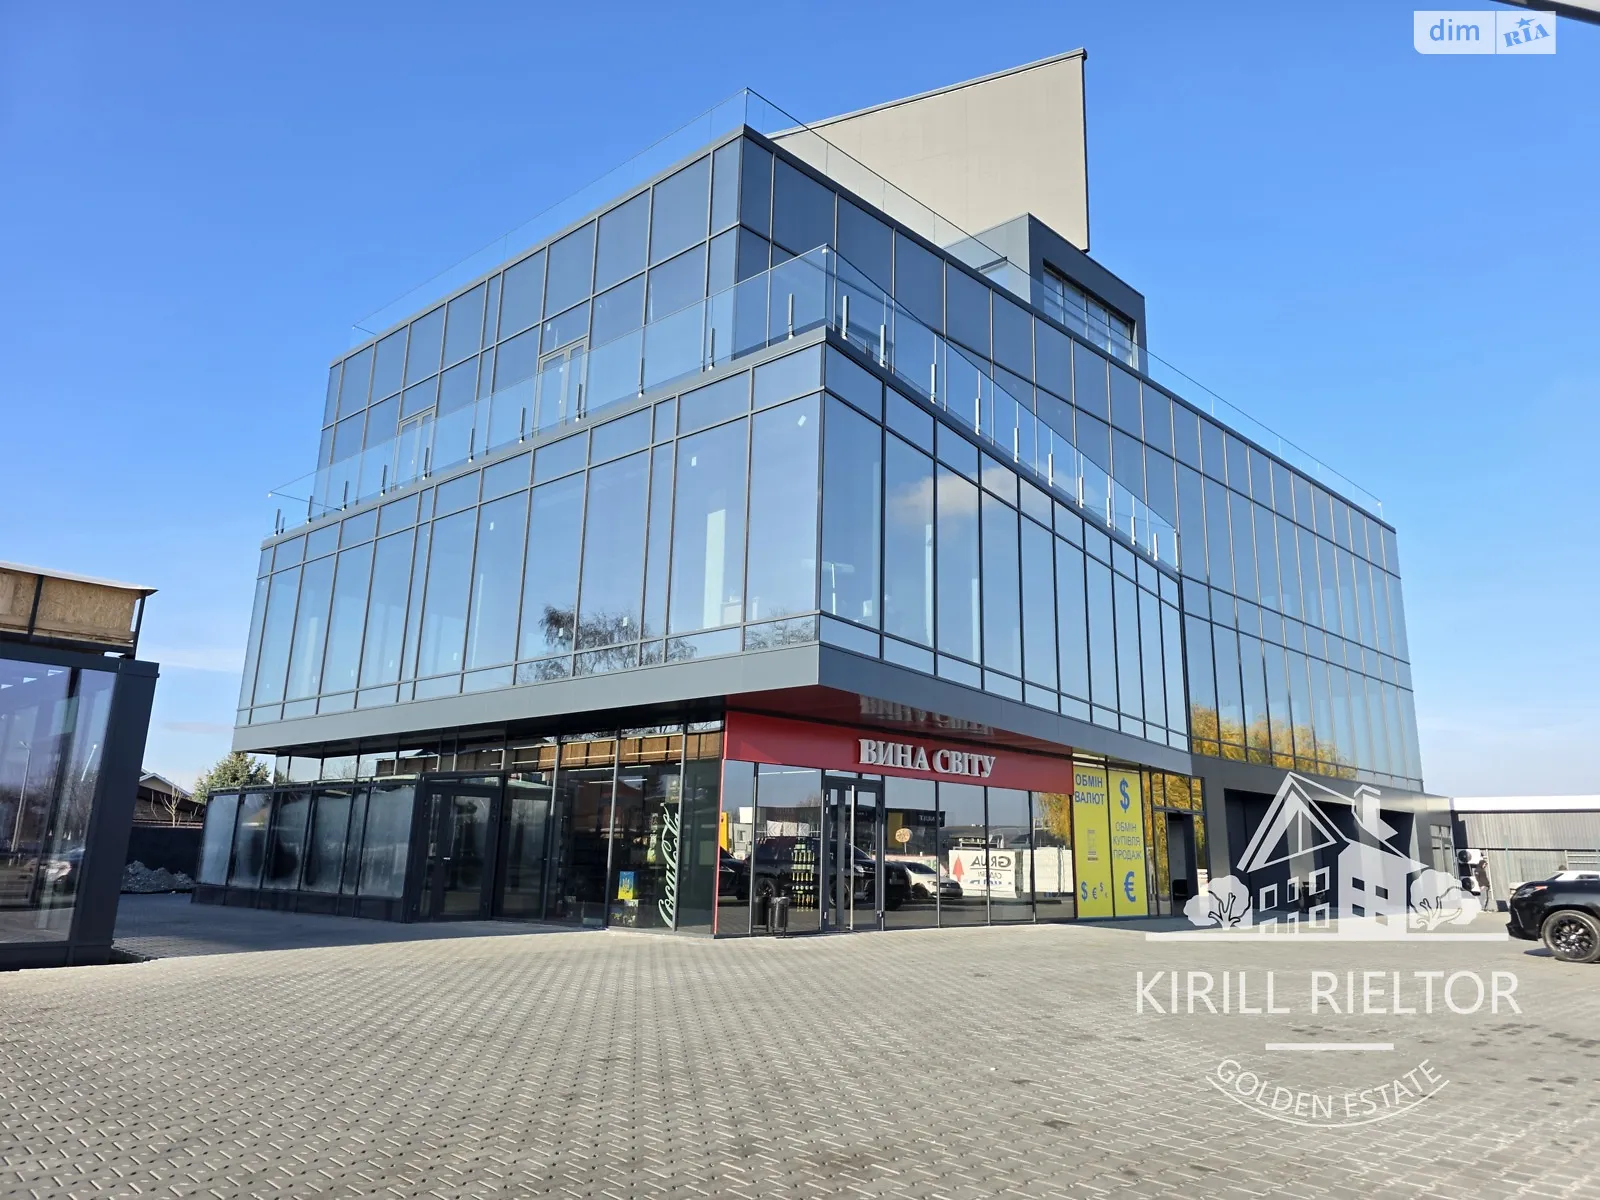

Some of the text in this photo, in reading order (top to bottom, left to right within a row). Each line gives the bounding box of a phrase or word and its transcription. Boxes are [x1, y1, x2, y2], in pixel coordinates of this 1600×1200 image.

[858, 738, 996, 778] ВИНА СВІТУ
[1075, 773, 1103, 788] ОБМІН
[1074, 791, 1104, 805] ВАЛЮТ
[1115, 821, 1136, 832] ОБМІН
[1112, 836, 1141, 847] КУПІВЛЯ
[1112, 849, 1142, 861] ПРОДАЖ
